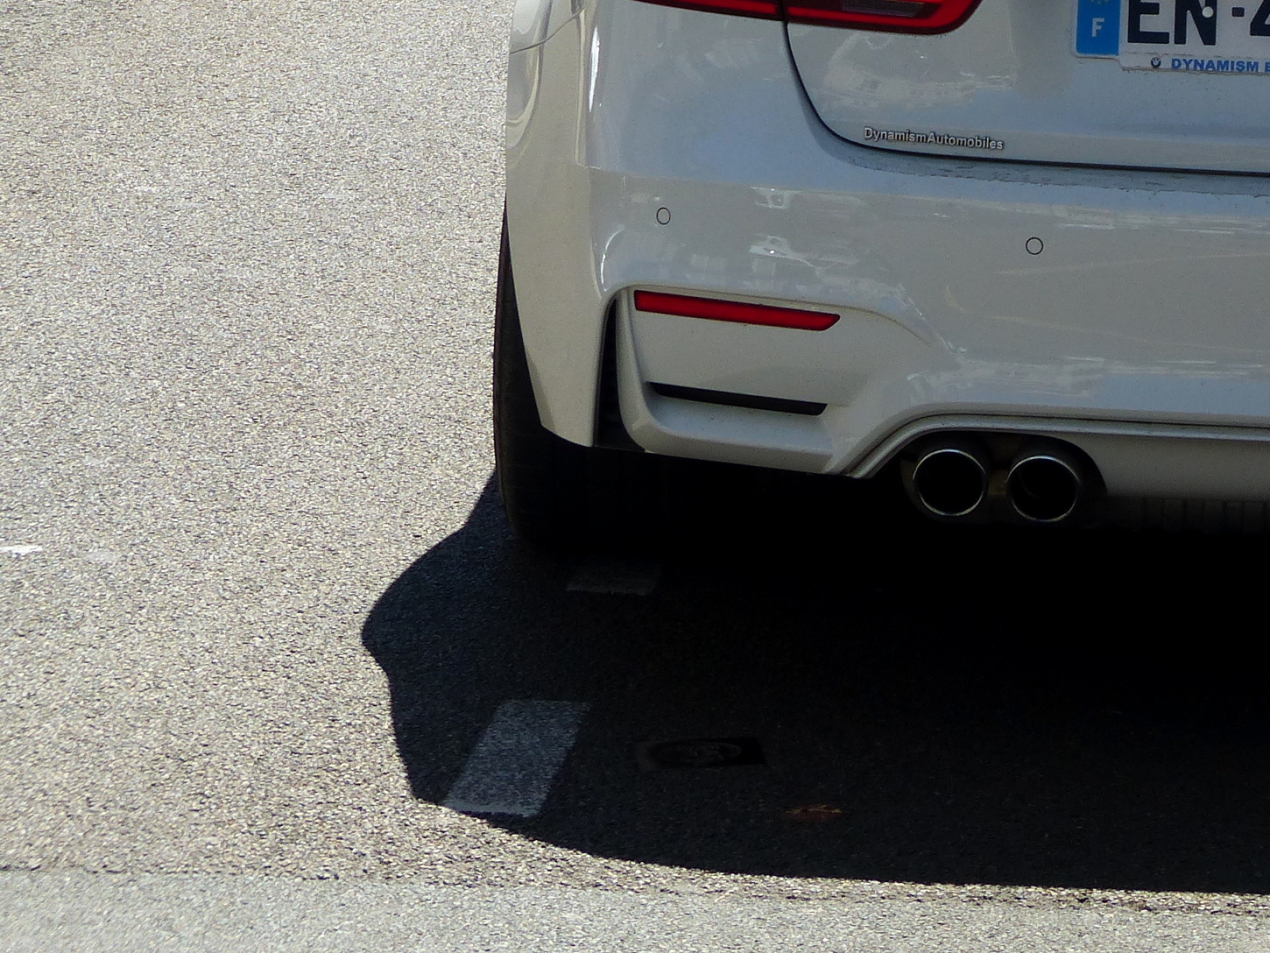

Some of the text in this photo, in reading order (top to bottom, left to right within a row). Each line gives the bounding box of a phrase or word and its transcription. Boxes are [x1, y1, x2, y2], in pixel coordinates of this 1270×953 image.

[1092, 17, 1105, 37] F
[1171, 58, 1259, 73] DYNAMISM
[864, 126, 1004, 150] DynamismAutomobiles
